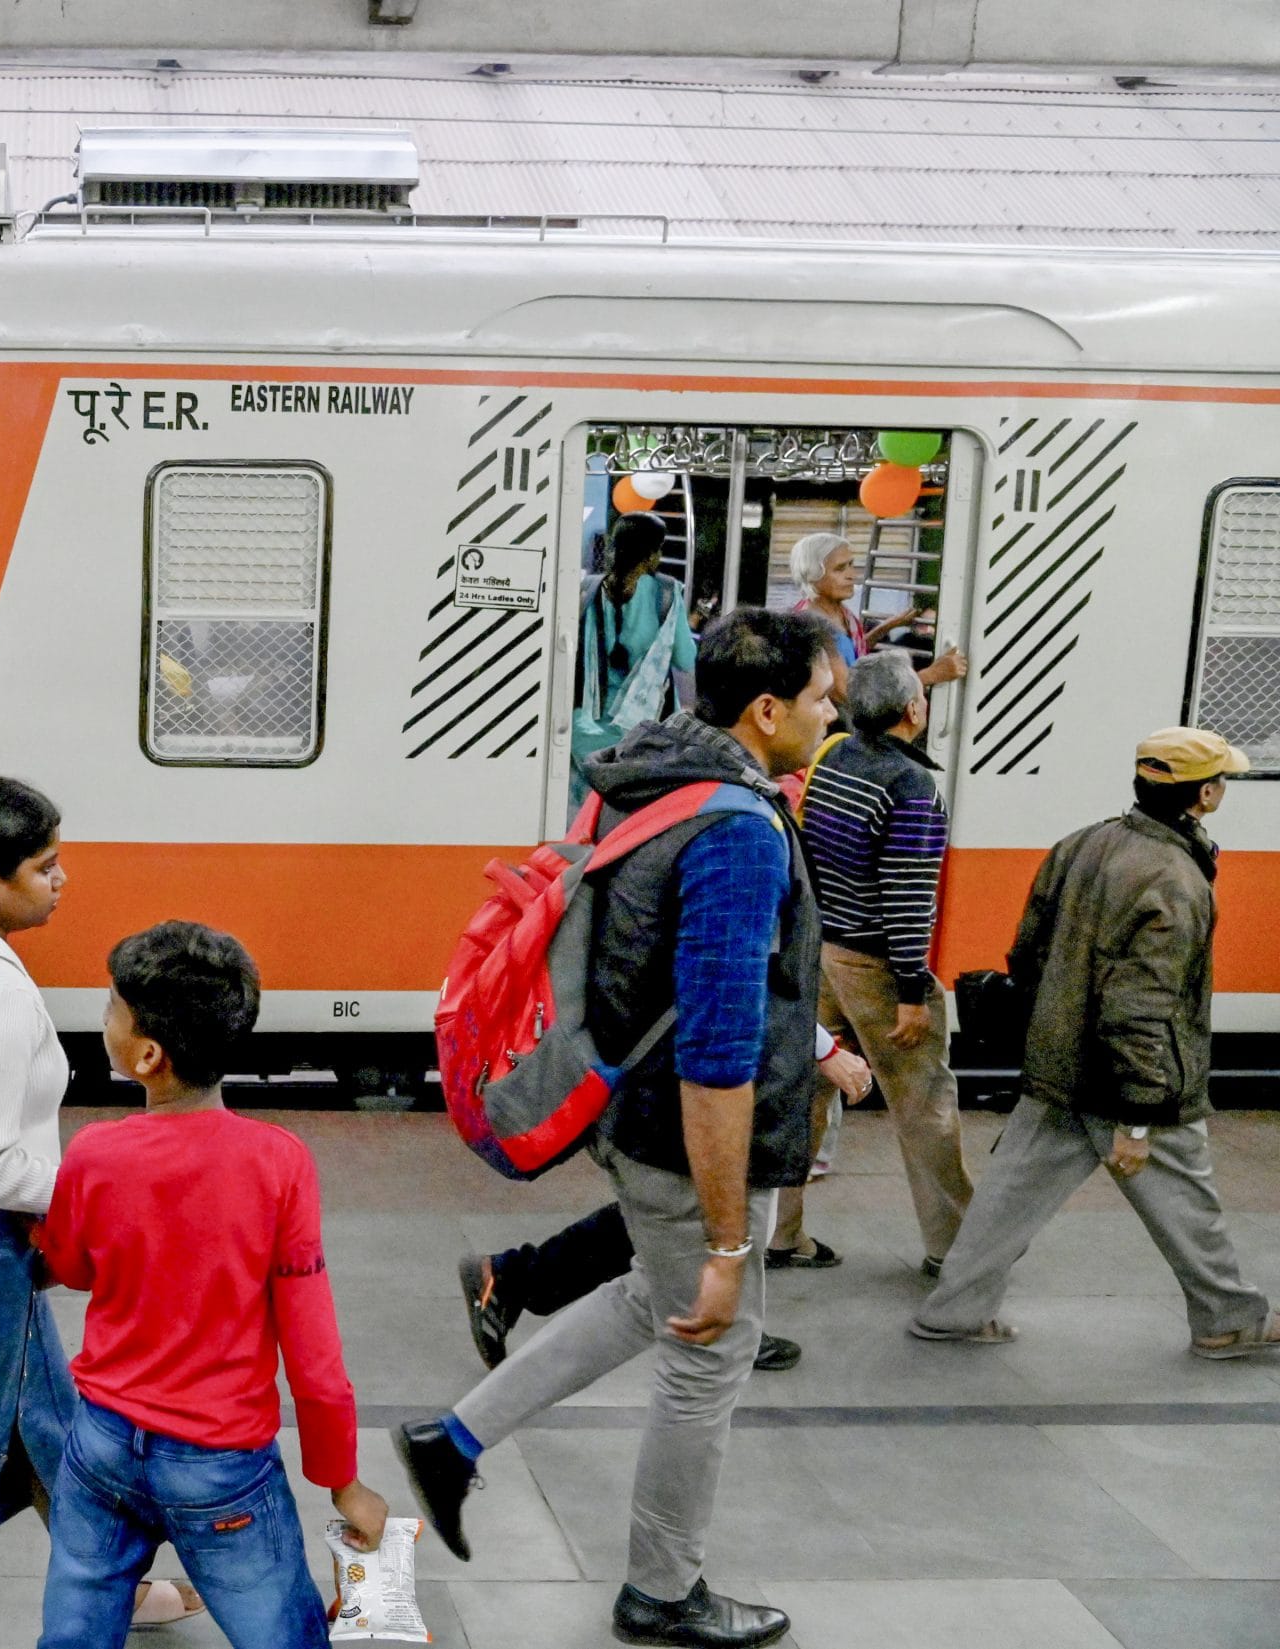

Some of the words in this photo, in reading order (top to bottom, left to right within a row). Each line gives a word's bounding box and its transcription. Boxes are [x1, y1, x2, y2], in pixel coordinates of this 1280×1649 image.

[143, 391, 209, 430] E.R.
[231, 384, 320, 412] EASTERN
[327, 386, 414, 415] RAILWAY
[488, 594, 514, 602] Ladies
[516, 596, 535, 605] Only
[333, 1001, 360, 1017] BIC
